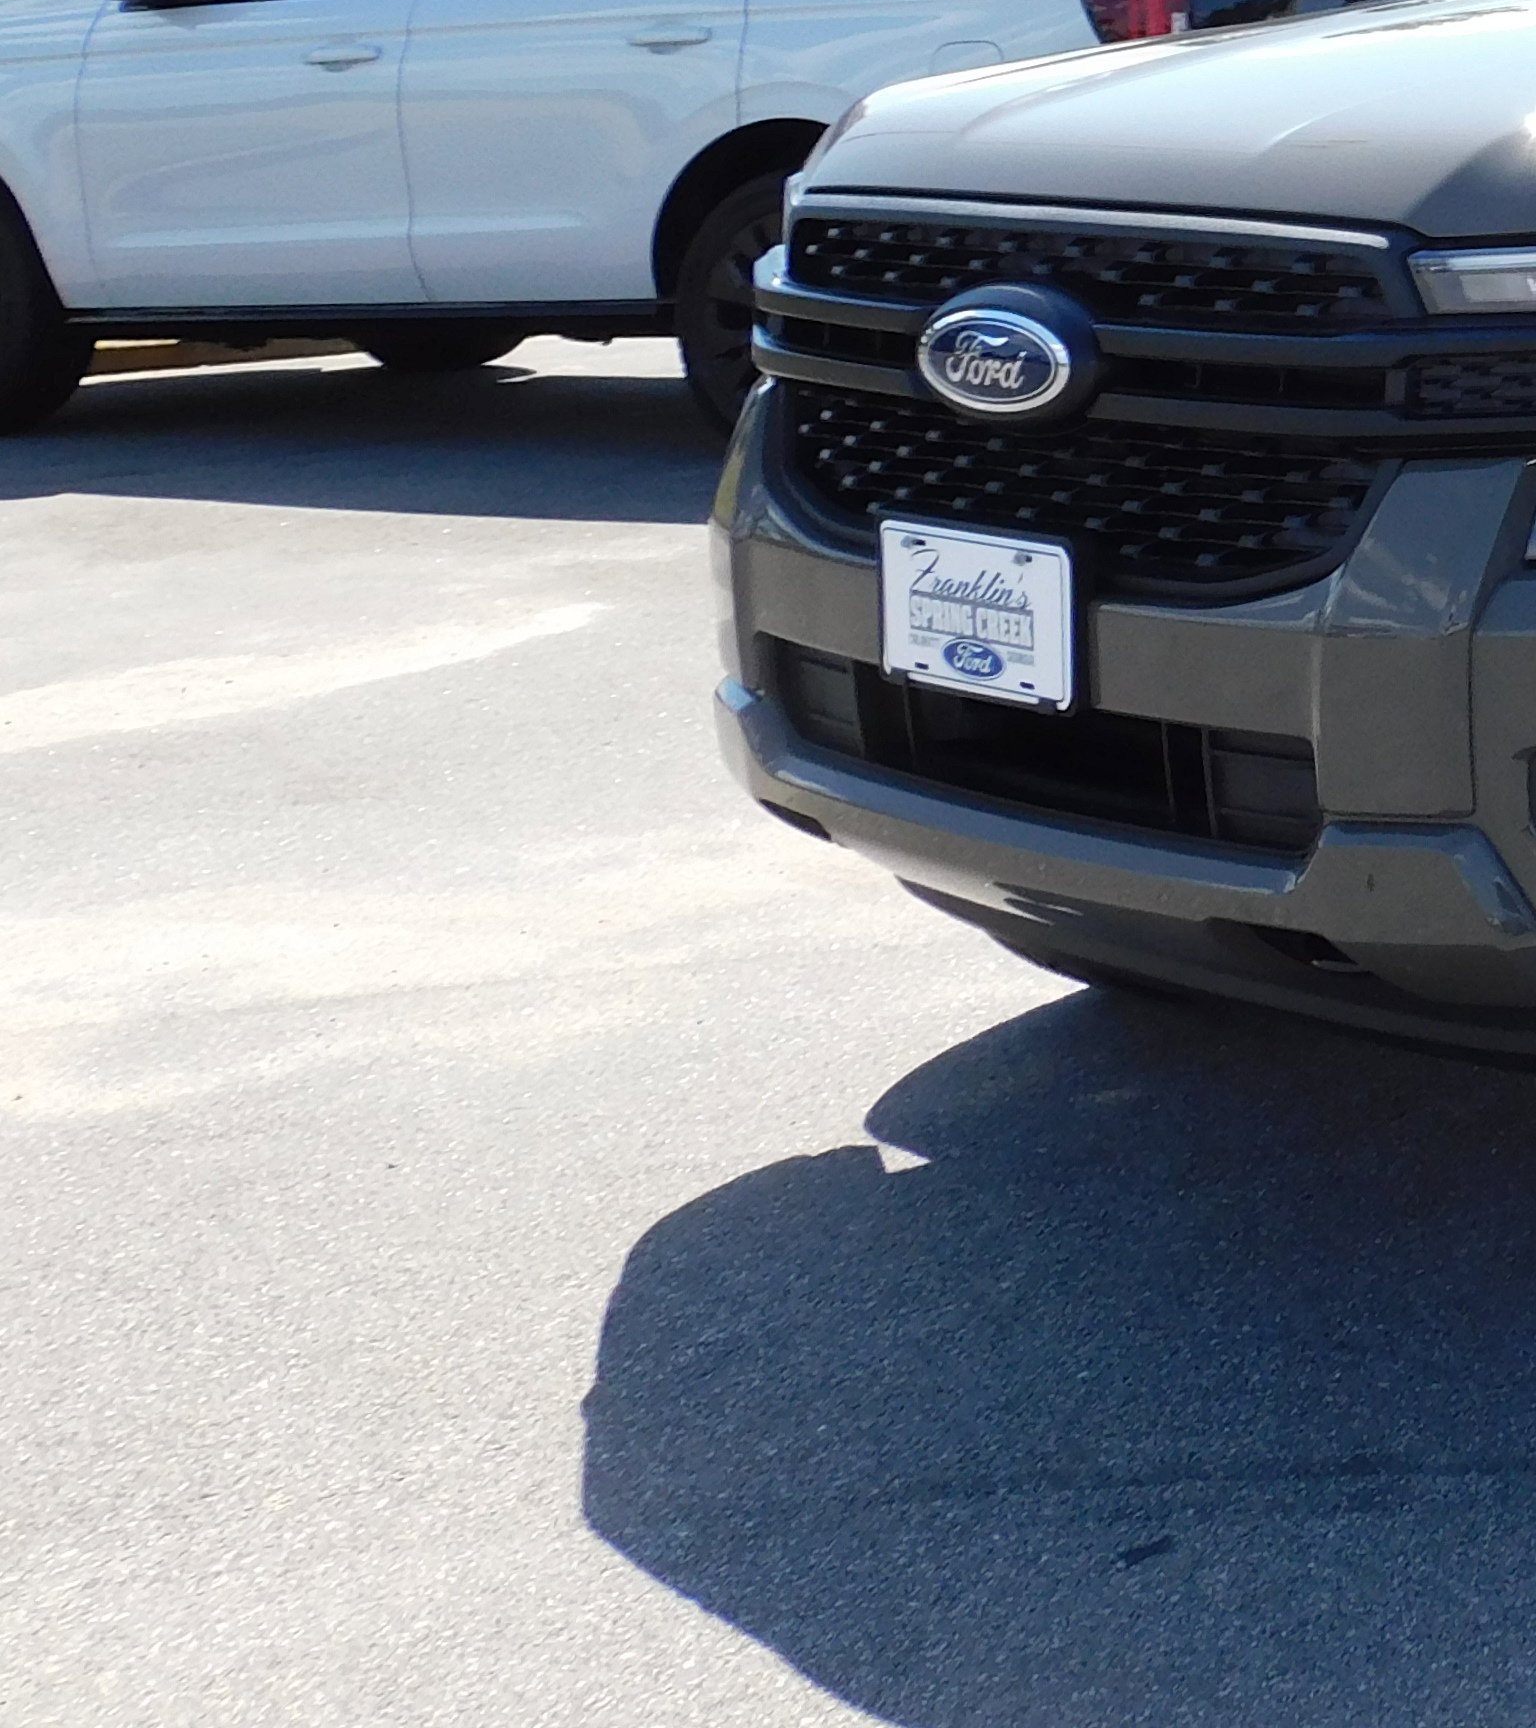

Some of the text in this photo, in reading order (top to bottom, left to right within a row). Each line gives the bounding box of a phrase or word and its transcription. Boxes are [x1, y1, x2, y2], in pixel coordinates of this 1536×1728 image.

[946, 330, 1027, 389] Ford
[911, 548, 1030, 609] Franklin's
[911, 594, 1033, 648] SPRING CREEK
[953, 643, 992, 673] Ford
